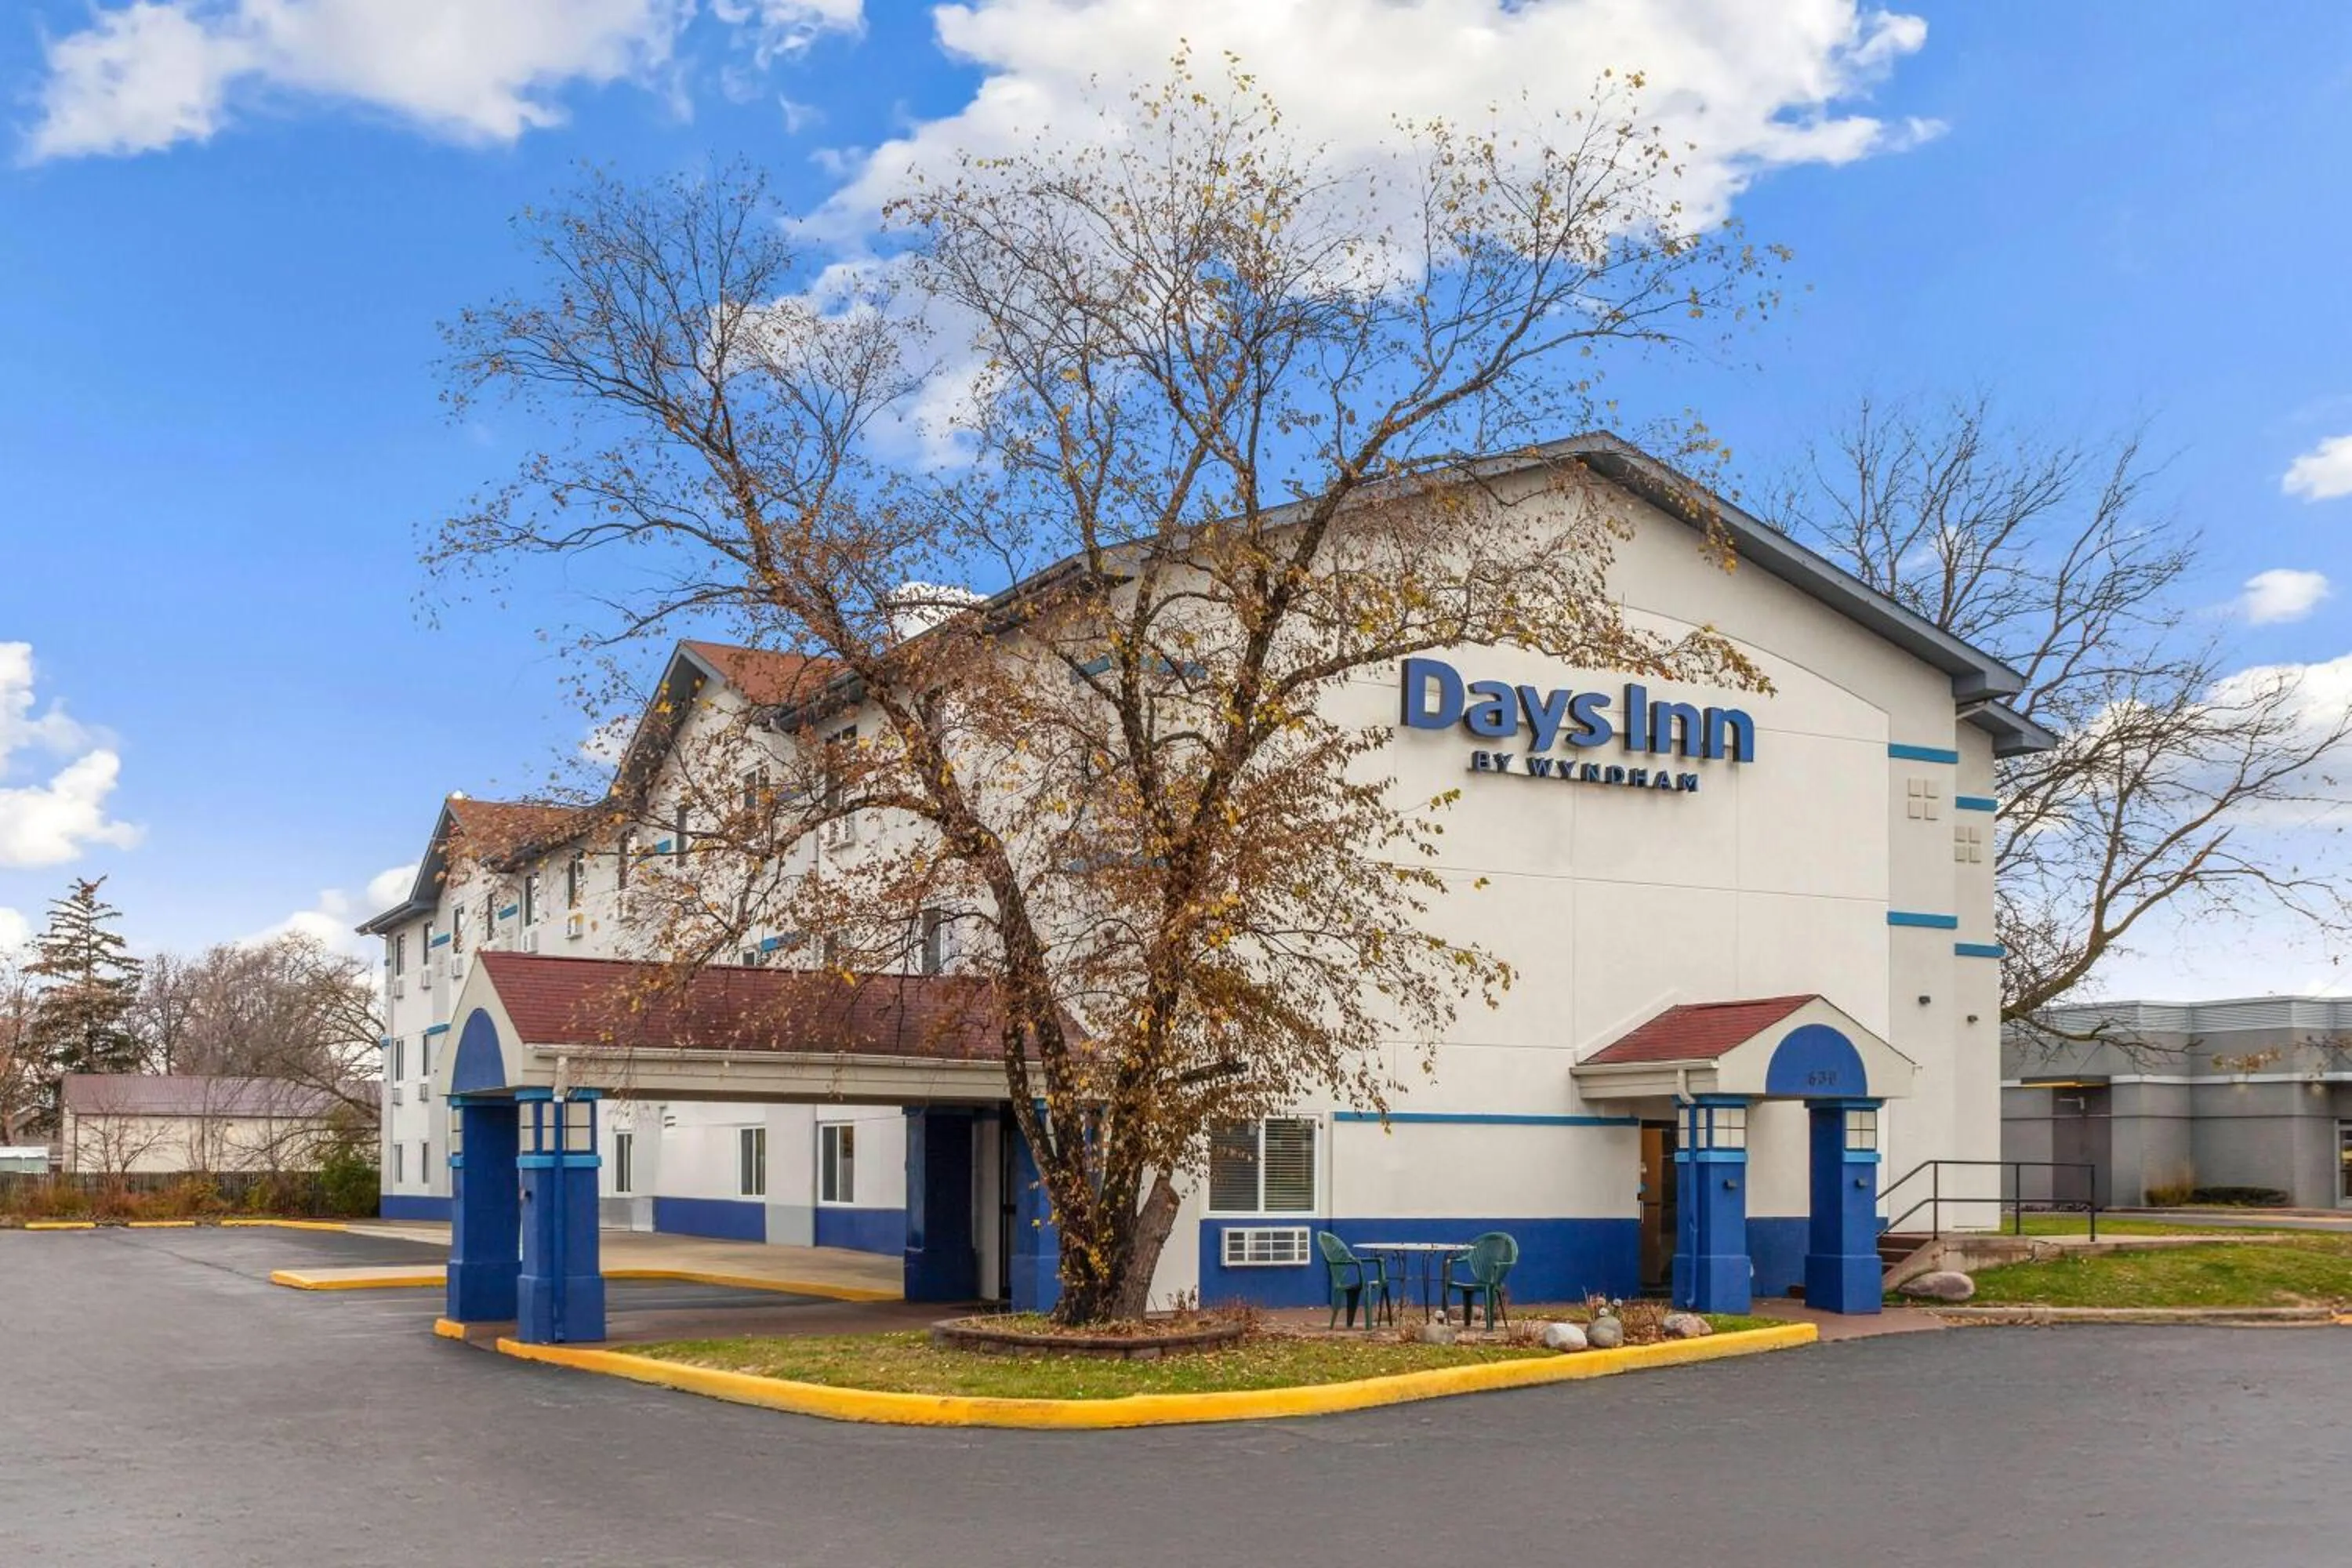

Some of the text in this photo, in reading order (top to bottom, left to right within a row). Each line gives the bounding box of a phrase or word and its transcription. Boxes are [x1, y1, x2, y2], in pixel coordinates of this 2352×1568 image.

[1401, 657, 1755, 763] Days Inn
[1472, 750, 1699, 793] BY WYNDHAM
